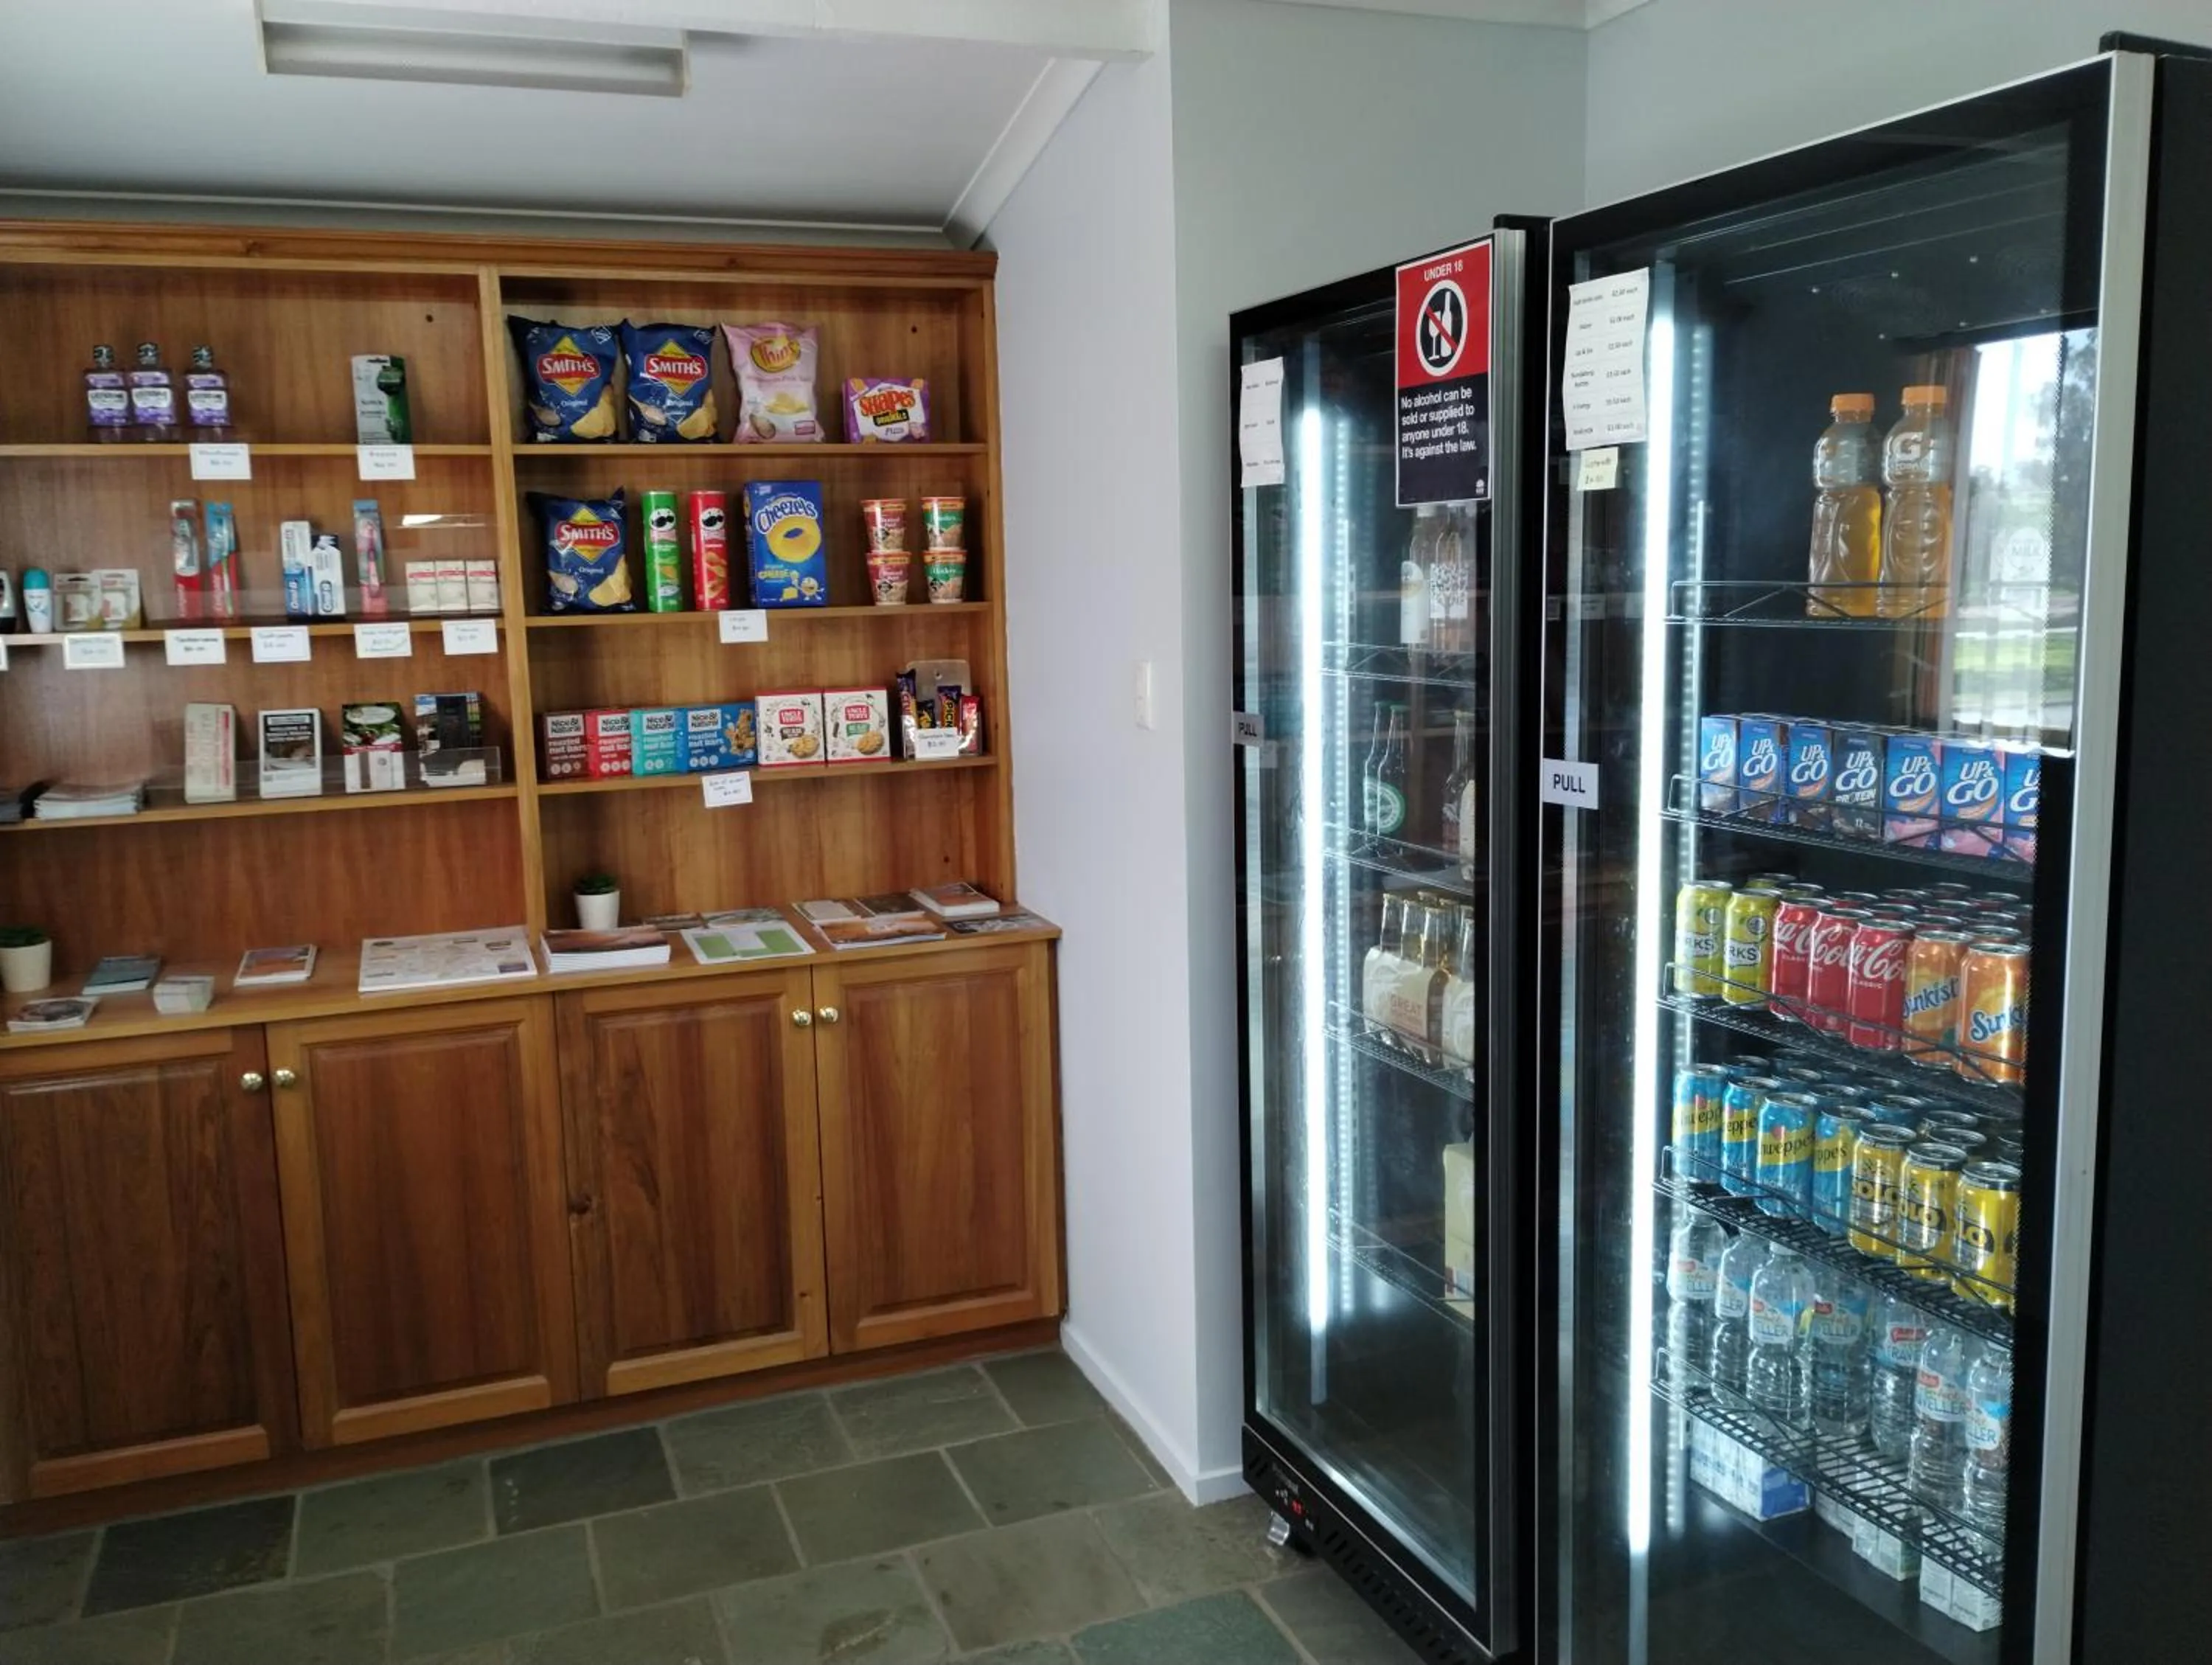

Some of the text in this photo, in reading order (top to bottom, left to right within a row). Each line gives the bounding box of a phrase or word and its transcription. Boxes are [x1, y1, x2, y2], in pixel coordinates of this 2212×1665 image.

[1424, 260, 1464, 282] UNDER 18
[542, 358, 596, 375] SMITH'S
[648, 358, 702, 375] SMITH'S
[1401, 386, 1472, 409] No alcohol can be
[1402, 403, 1475, 426] sold or supplied to
[1402, 421, 1470, 443] anyone under 18.
[1402, 439, 1477, 459] It's against the law.
[757, 498, 818, 532] Cheezels
[560, 524, 615, 541] SMITH'S
[945, 701, 954, 728] PICN
[1703, 748, 1733, 771] GO
[1742, 753, 1778, 776] GO
[1790, 759, 1828, 783] GO
[1553, 773, 1586, 794] PULL
[1835, 766, 1878, 791] GO
[1889, 772, 1937, 798] GO
[1947, 776, 1999, 804] GO
[1729, 945, 1758, 960] RKS
[1902, 976, 1959, 1020] unkist
